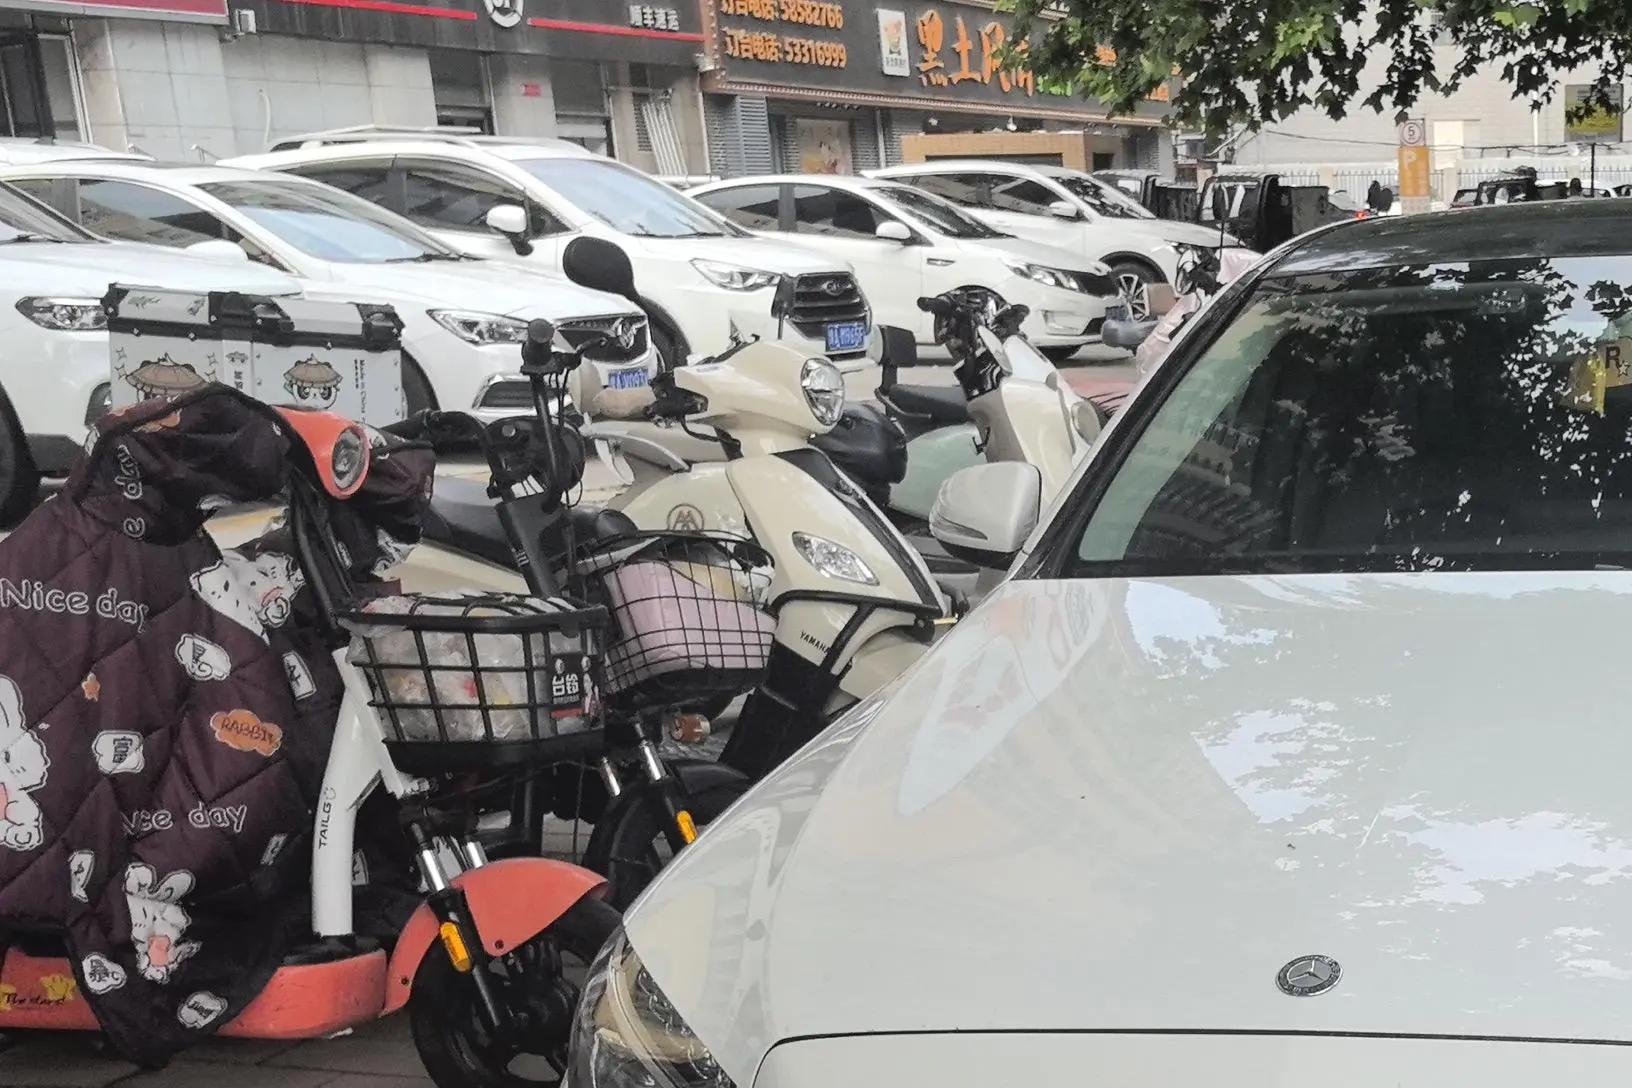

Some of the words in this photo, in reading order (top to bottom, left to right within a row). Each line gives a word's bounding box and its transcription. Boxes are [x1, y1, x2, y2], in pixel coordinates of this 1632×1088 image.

[629, 4, 680, 31] 顺丰速运
[1605, 346, 1621, 368] R
[0, 578, 90, 616] Nice
[96, 587, 150, 634] day
[188, 801, 248, 833] day
